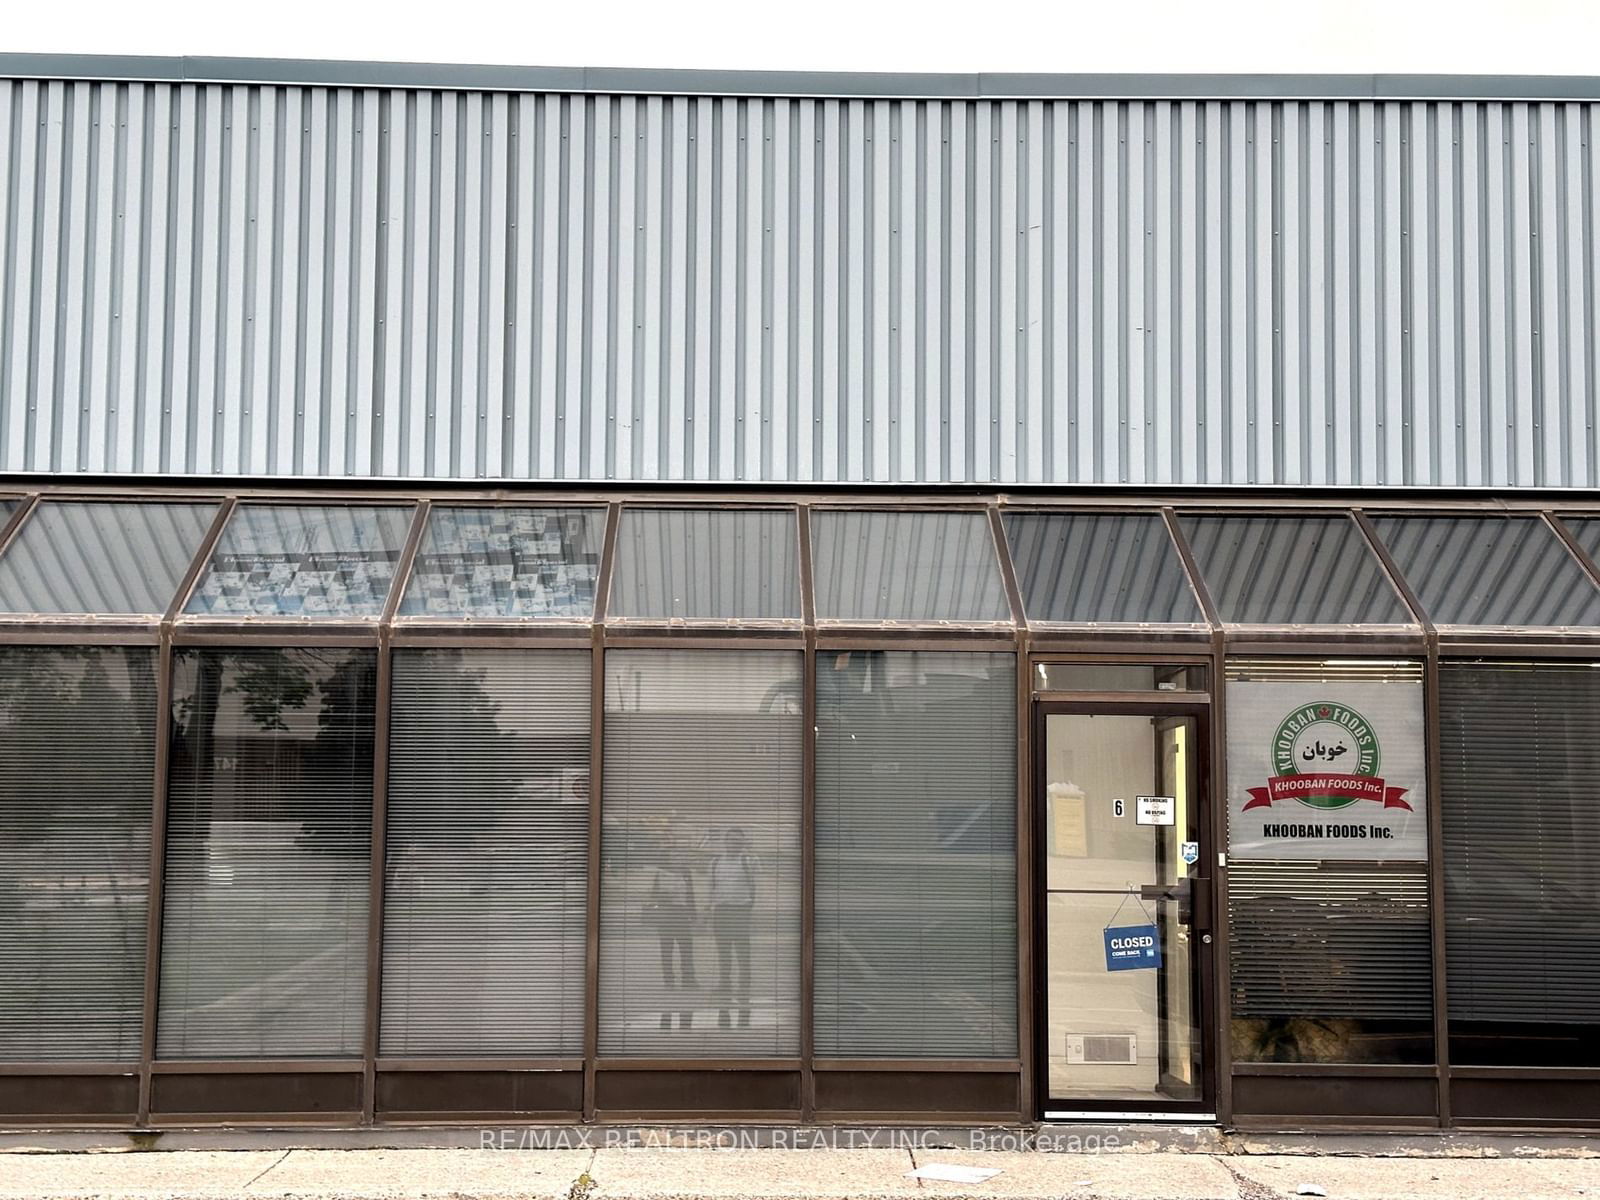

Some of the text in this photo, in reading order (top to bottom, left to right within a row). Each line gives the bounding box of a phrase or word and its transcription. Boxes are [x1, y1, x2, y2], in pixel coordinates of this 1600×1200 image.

[1277, 708, 1316, 770] KHOOBAN
[1333, 708, 1371, 746] FOODS
[1302, 740, 1348, 761] خوبان
[1275, 779, 1382, 793] KHOOBAN FOODS Inc.
[1115, 800, 1123, 816] 6
[1263, 824, 1394, 839] KHOOBAN FOODS Inc.
[1111, 936, 1153, 949] CLOSED
